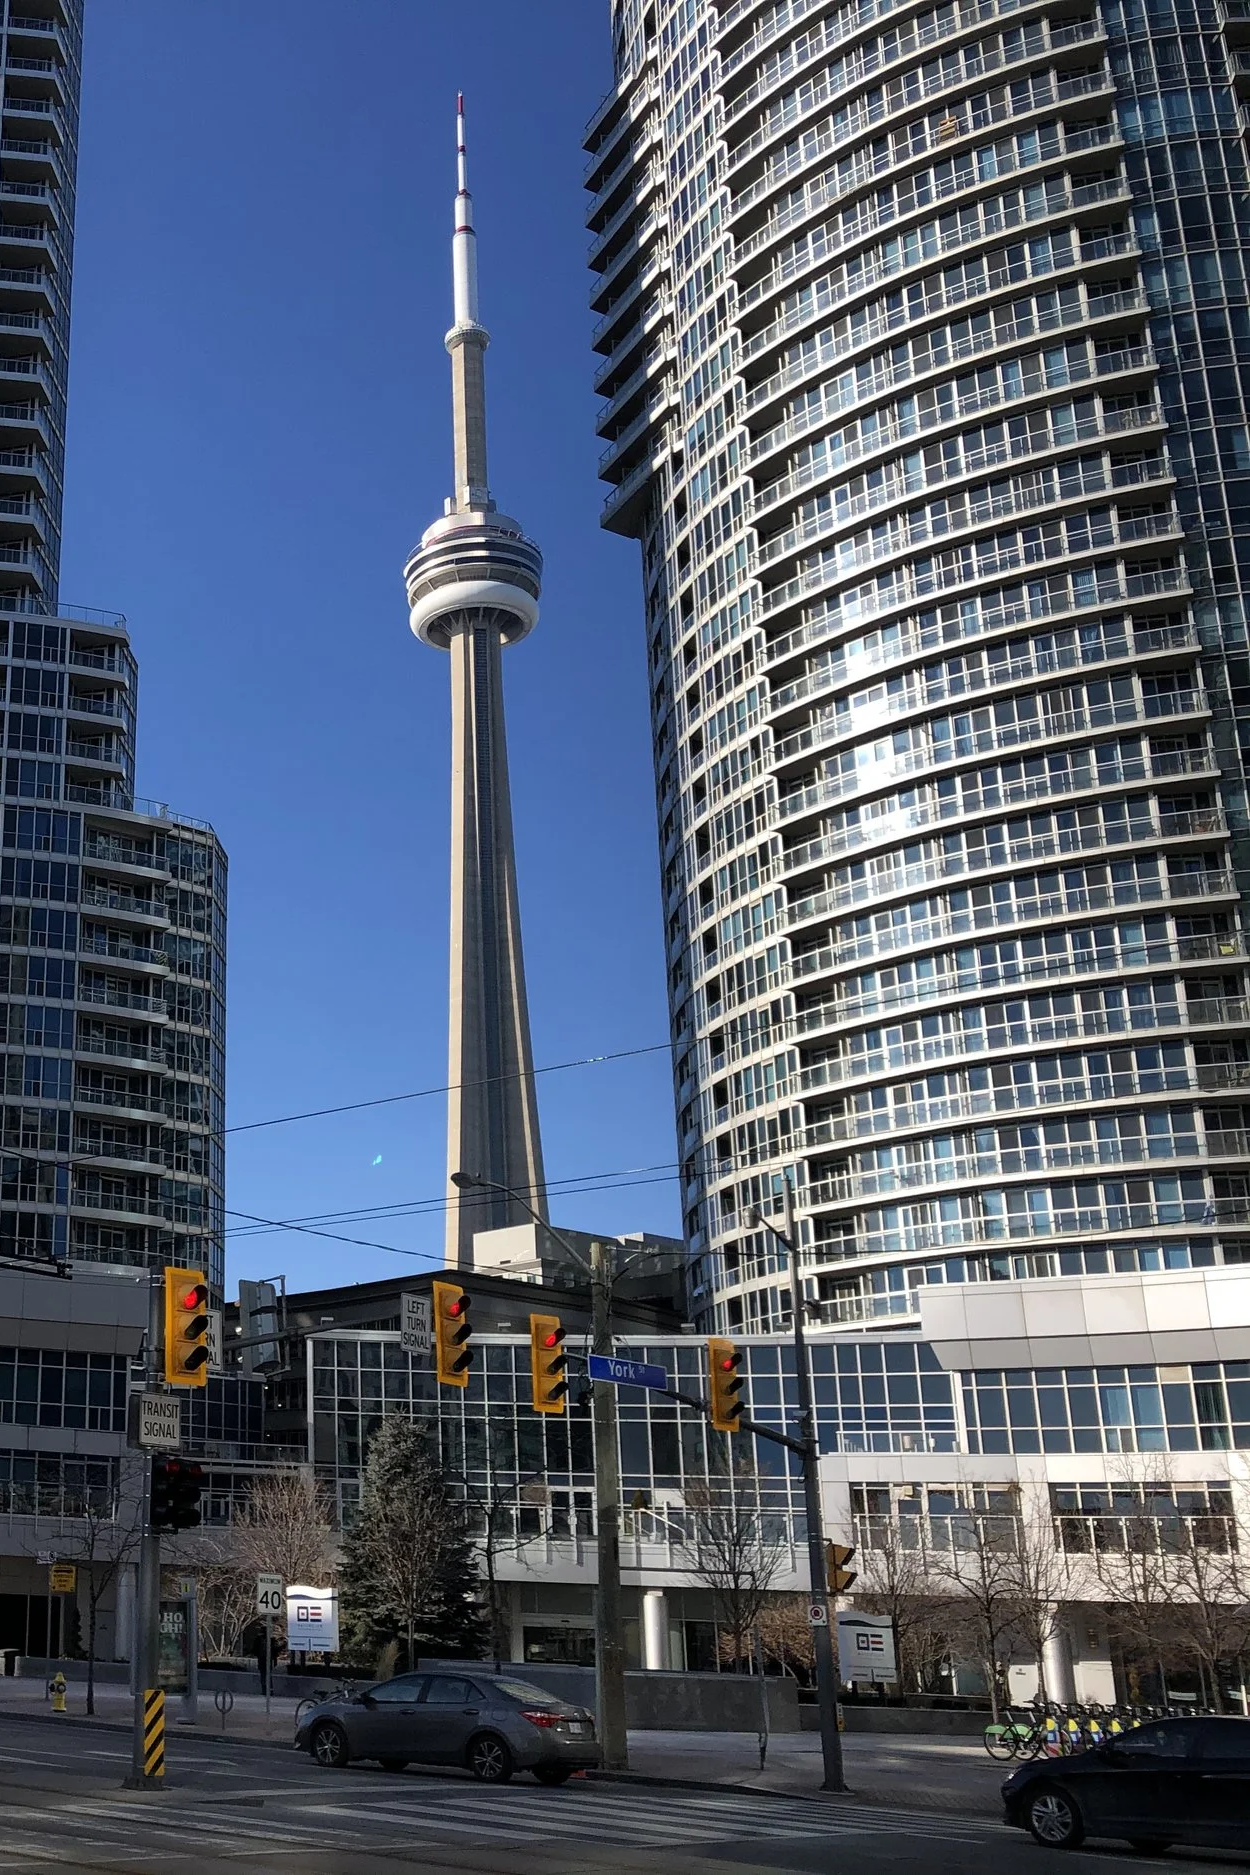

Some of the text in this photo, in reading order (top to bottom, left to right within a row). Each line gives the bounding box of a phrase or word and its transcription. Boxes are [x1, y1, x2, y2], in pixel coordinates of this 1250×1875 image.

[407, 1299, 425, 1315] LEFT
[407, 1316, 427, 1332] TURN
[403, 1331, 429, 1350] SIGNAL
[608, 1360, 636, 1379] York
[142, 1401, 179, 1420] TRANSIT
[144, 1421, 177, 1439] SIGNAL
[259, 1590, 281, 1610] 40
